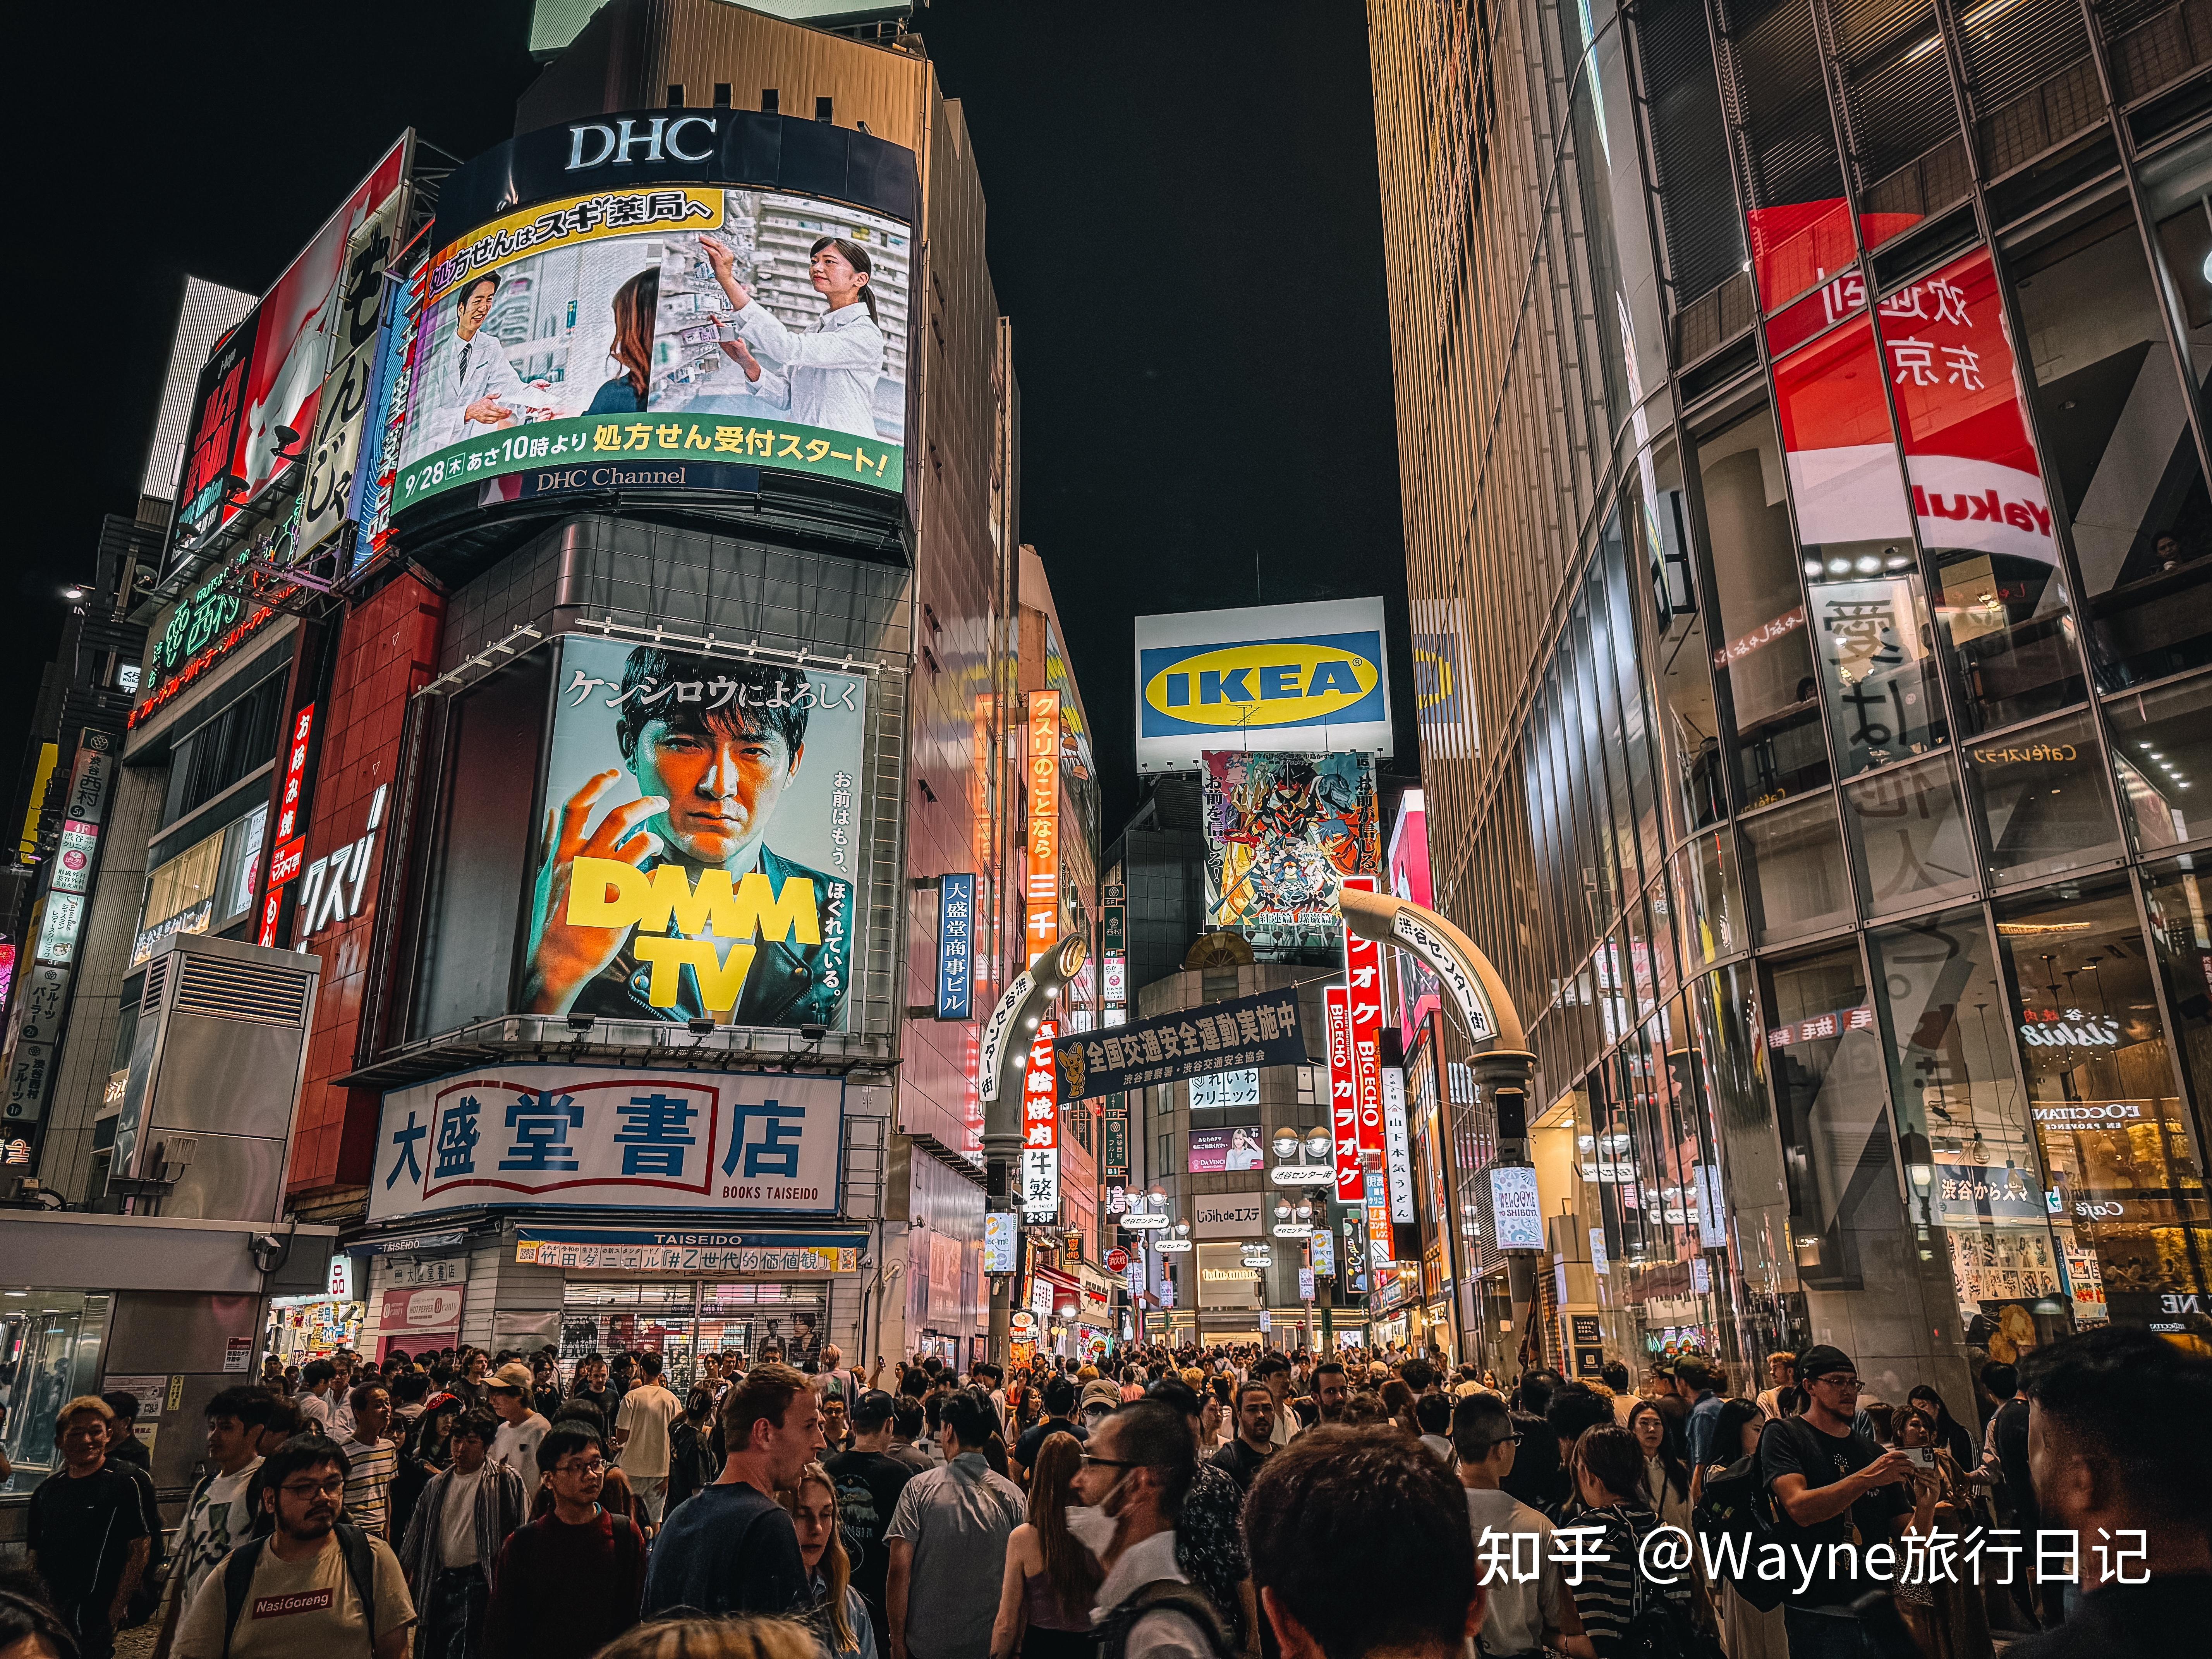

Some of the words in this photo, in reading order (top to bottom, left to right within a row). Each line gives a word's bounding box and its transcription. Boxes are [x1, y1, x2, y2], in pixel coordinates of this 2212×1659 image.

[565, 117, 716, 170] DHC
[428, 190, 712, 297] 処方せんはスギ薬局へ
[537, 470, 587, 491] DHC
[592, 466, 686, 487] Channel
[564, 670, 857, 711] ケンシロウによろしく
[1166, 659, 1364, 708] IKEA
[279, 714, 310, 838] お好み焼
[1032, 697, 1054, 859] クスリのことなら
[73, 807, 82, 816] 5F
[73, 823, 91, 834] 4F
[62, 840, 94, 851] クリニック
[567, 855, 822, 945] DMM
[43, 910, 58, 957] レディースクリニック
[944, 882, 969, 1012] 大盛堂商事ビル
[634, 934, 757, 1012] TV
[1399, 916, 1485, 1032] 渋谷センター街
[33, 986, 46, 1024] パーラー
[45, 982, 61, 1020] フルーツ
[1331, 1003, 1343, 1031] BIG
[982, 980, 1027, 1097] 渋谷センター街
[1086, 1000, 1297, 1074] 全国交通安全運動実施中
[1333, 1031, 1346, 1068] ECHO
[12, 1062, 30, 1101] フルーツ
[1123, 1049, 1266, 1085] 渋谷警察署・渋谷交通安全協会
[1208, 1069, 1257, 1085] れいわ
[1027, 1045, 1054, 1147] 七輪焼肉
[1193, 1088, 1257, 1106] クリニック
[1362, 1077, 1379, 1127] ECHO
[386, 1089, 807, 1192] 大盛堂書店
[1334, 1079, 1360, 1187] カラオケ
[1030, 1151, 1052, 1201] 牛繁
[1274, 1171, 1333, 1180] 渋谷センター街
[1389, 1118, 1409, 1219] 山下本気うどん
[722, 1185, 761, 1200] BOOKS
[766, 1185, 819, 1201] TAISEIDO
[1197, 1207, 1259, 1223] じぶんdeエステ
[1507, 1209, 1538, 1217] SHIBUYA
[383, 1240, 420, 1252] TAISEIDO
[654, 1234, 742, 1245] TAISEIDO
[1109, 1255, 1127, 1266] 消火栓
[256, 1597, 283, 1613] Nasi
[285, 1593, 329, 1609] Goreng
